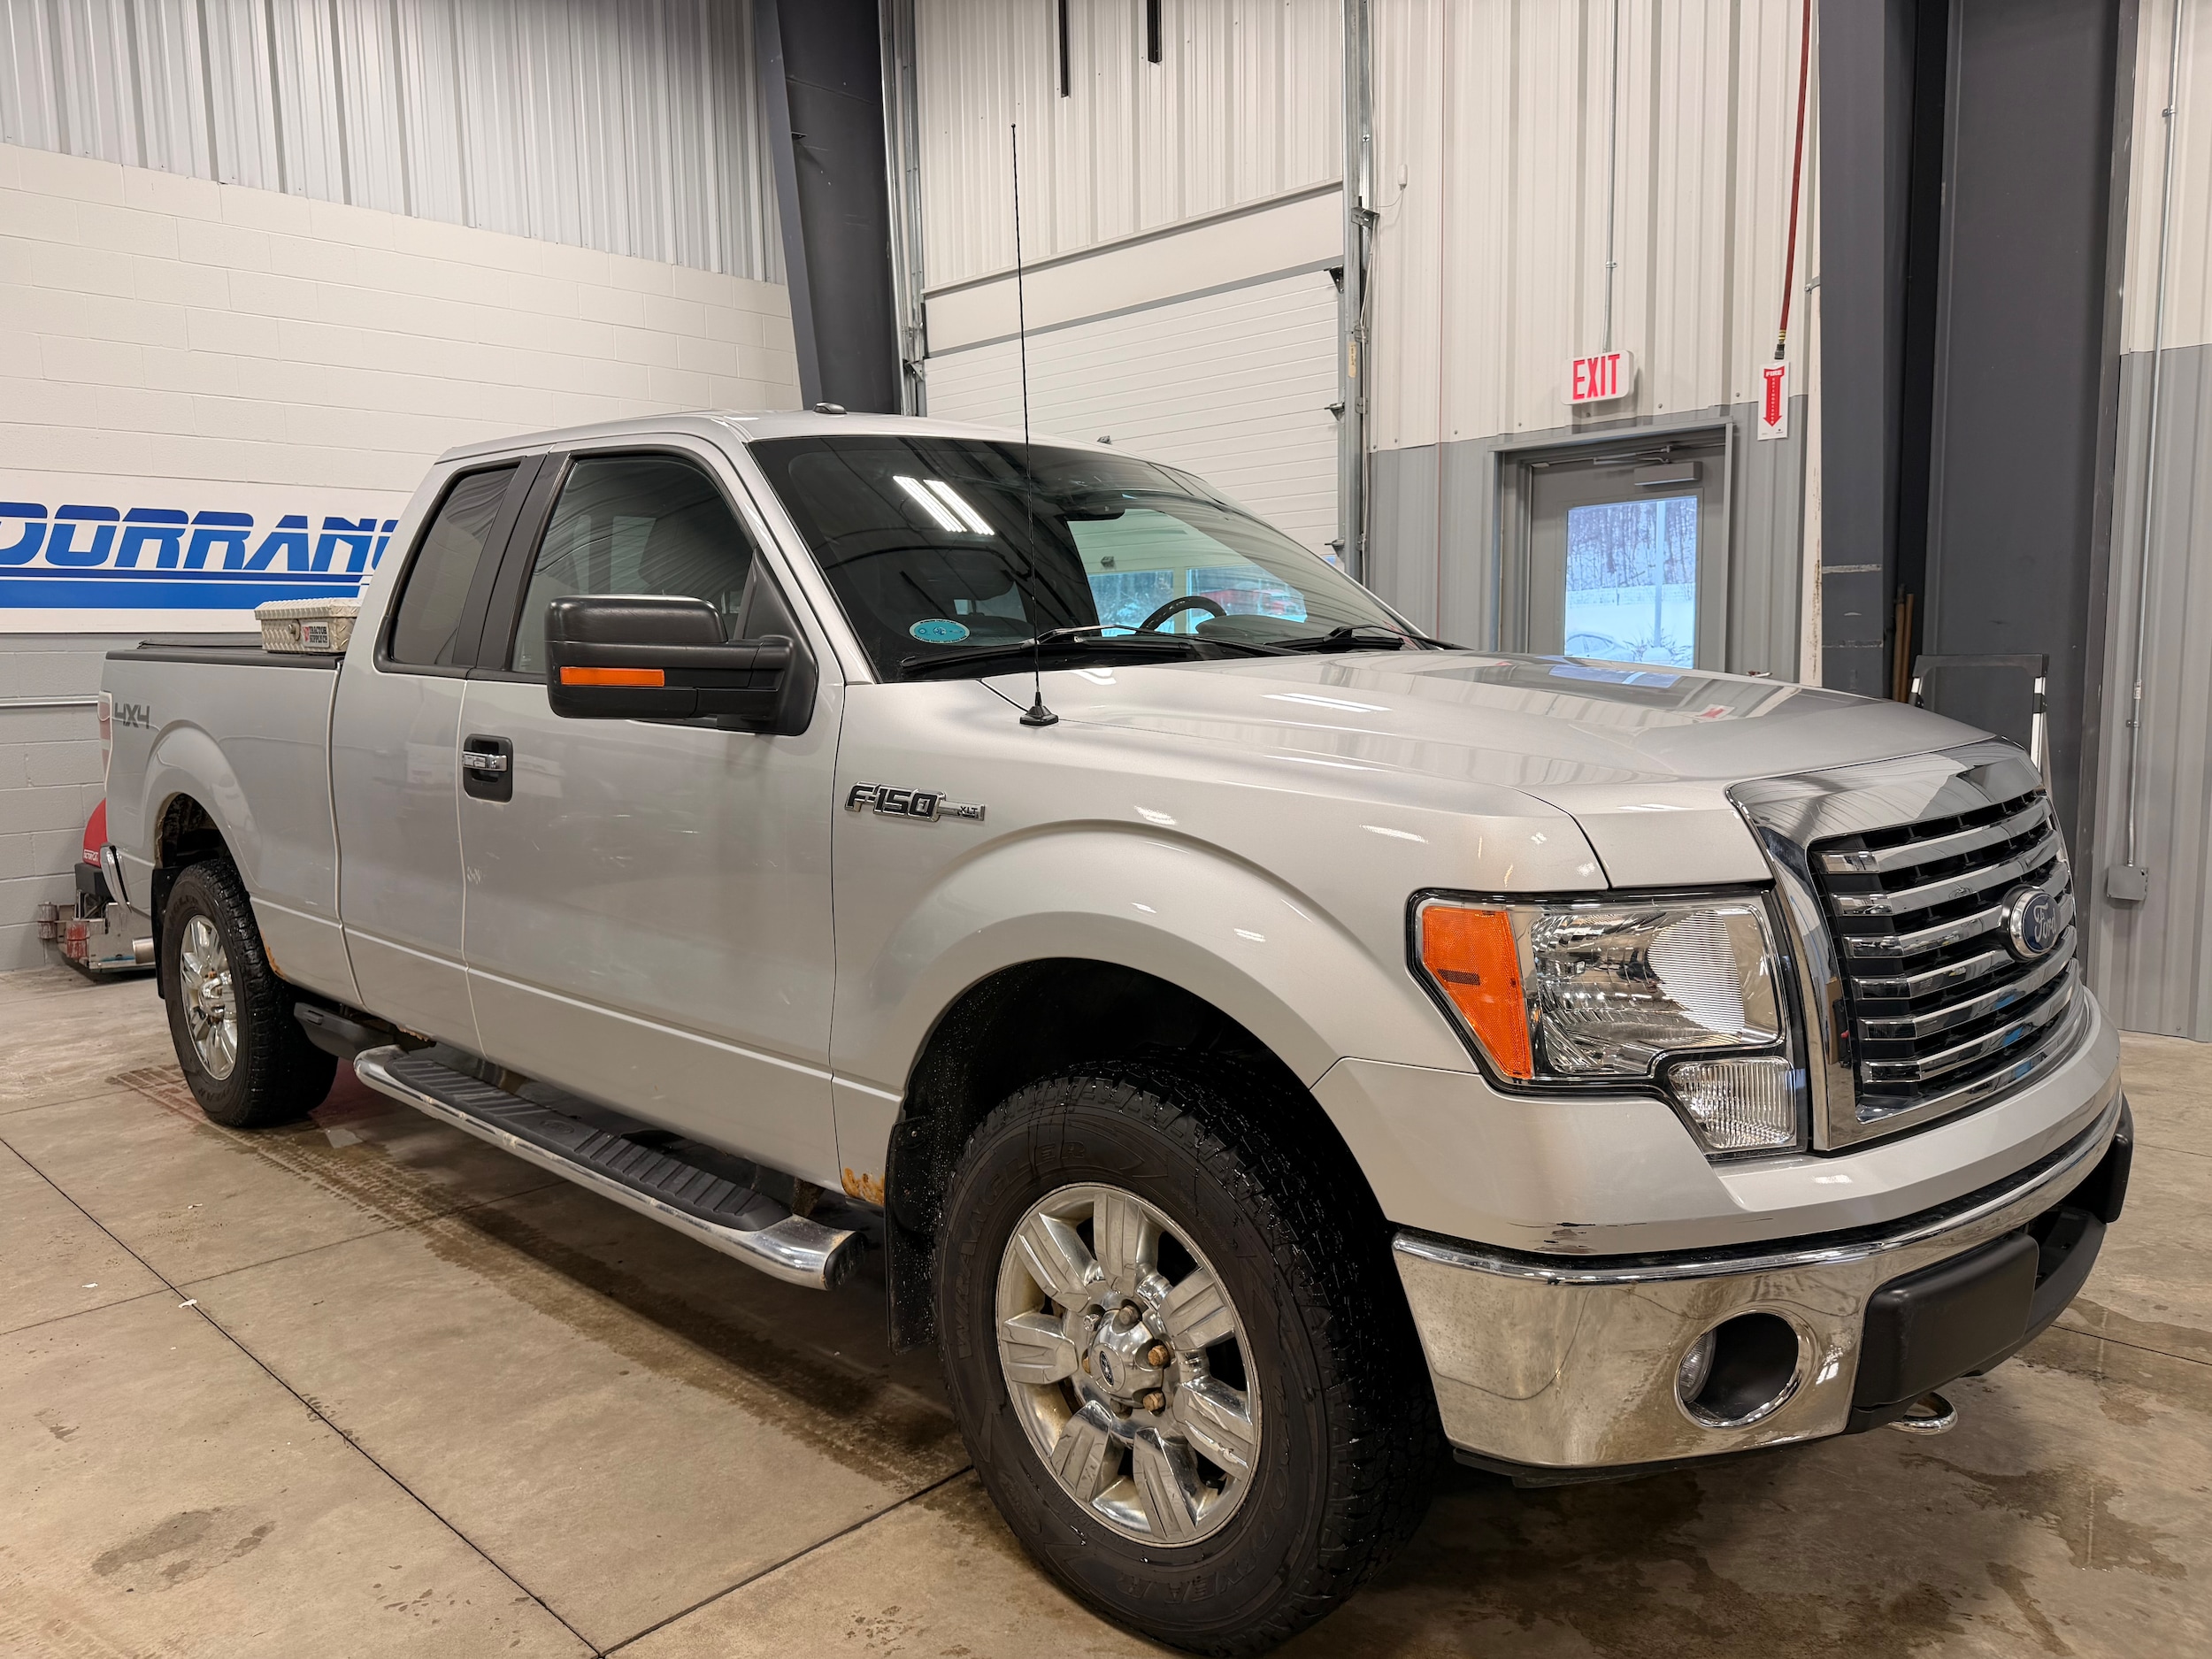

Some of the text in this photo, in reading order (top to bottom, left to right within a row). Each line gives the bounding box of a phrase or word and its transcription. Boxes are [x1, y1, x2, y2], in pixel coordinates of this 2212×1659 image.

[1572, 353, 1620, 400] EXIT
[309, 626, 327, 634] TRACTOR
[959, 805, 978, 816] XLT
[2033, 902, 2057, 943] Ford
